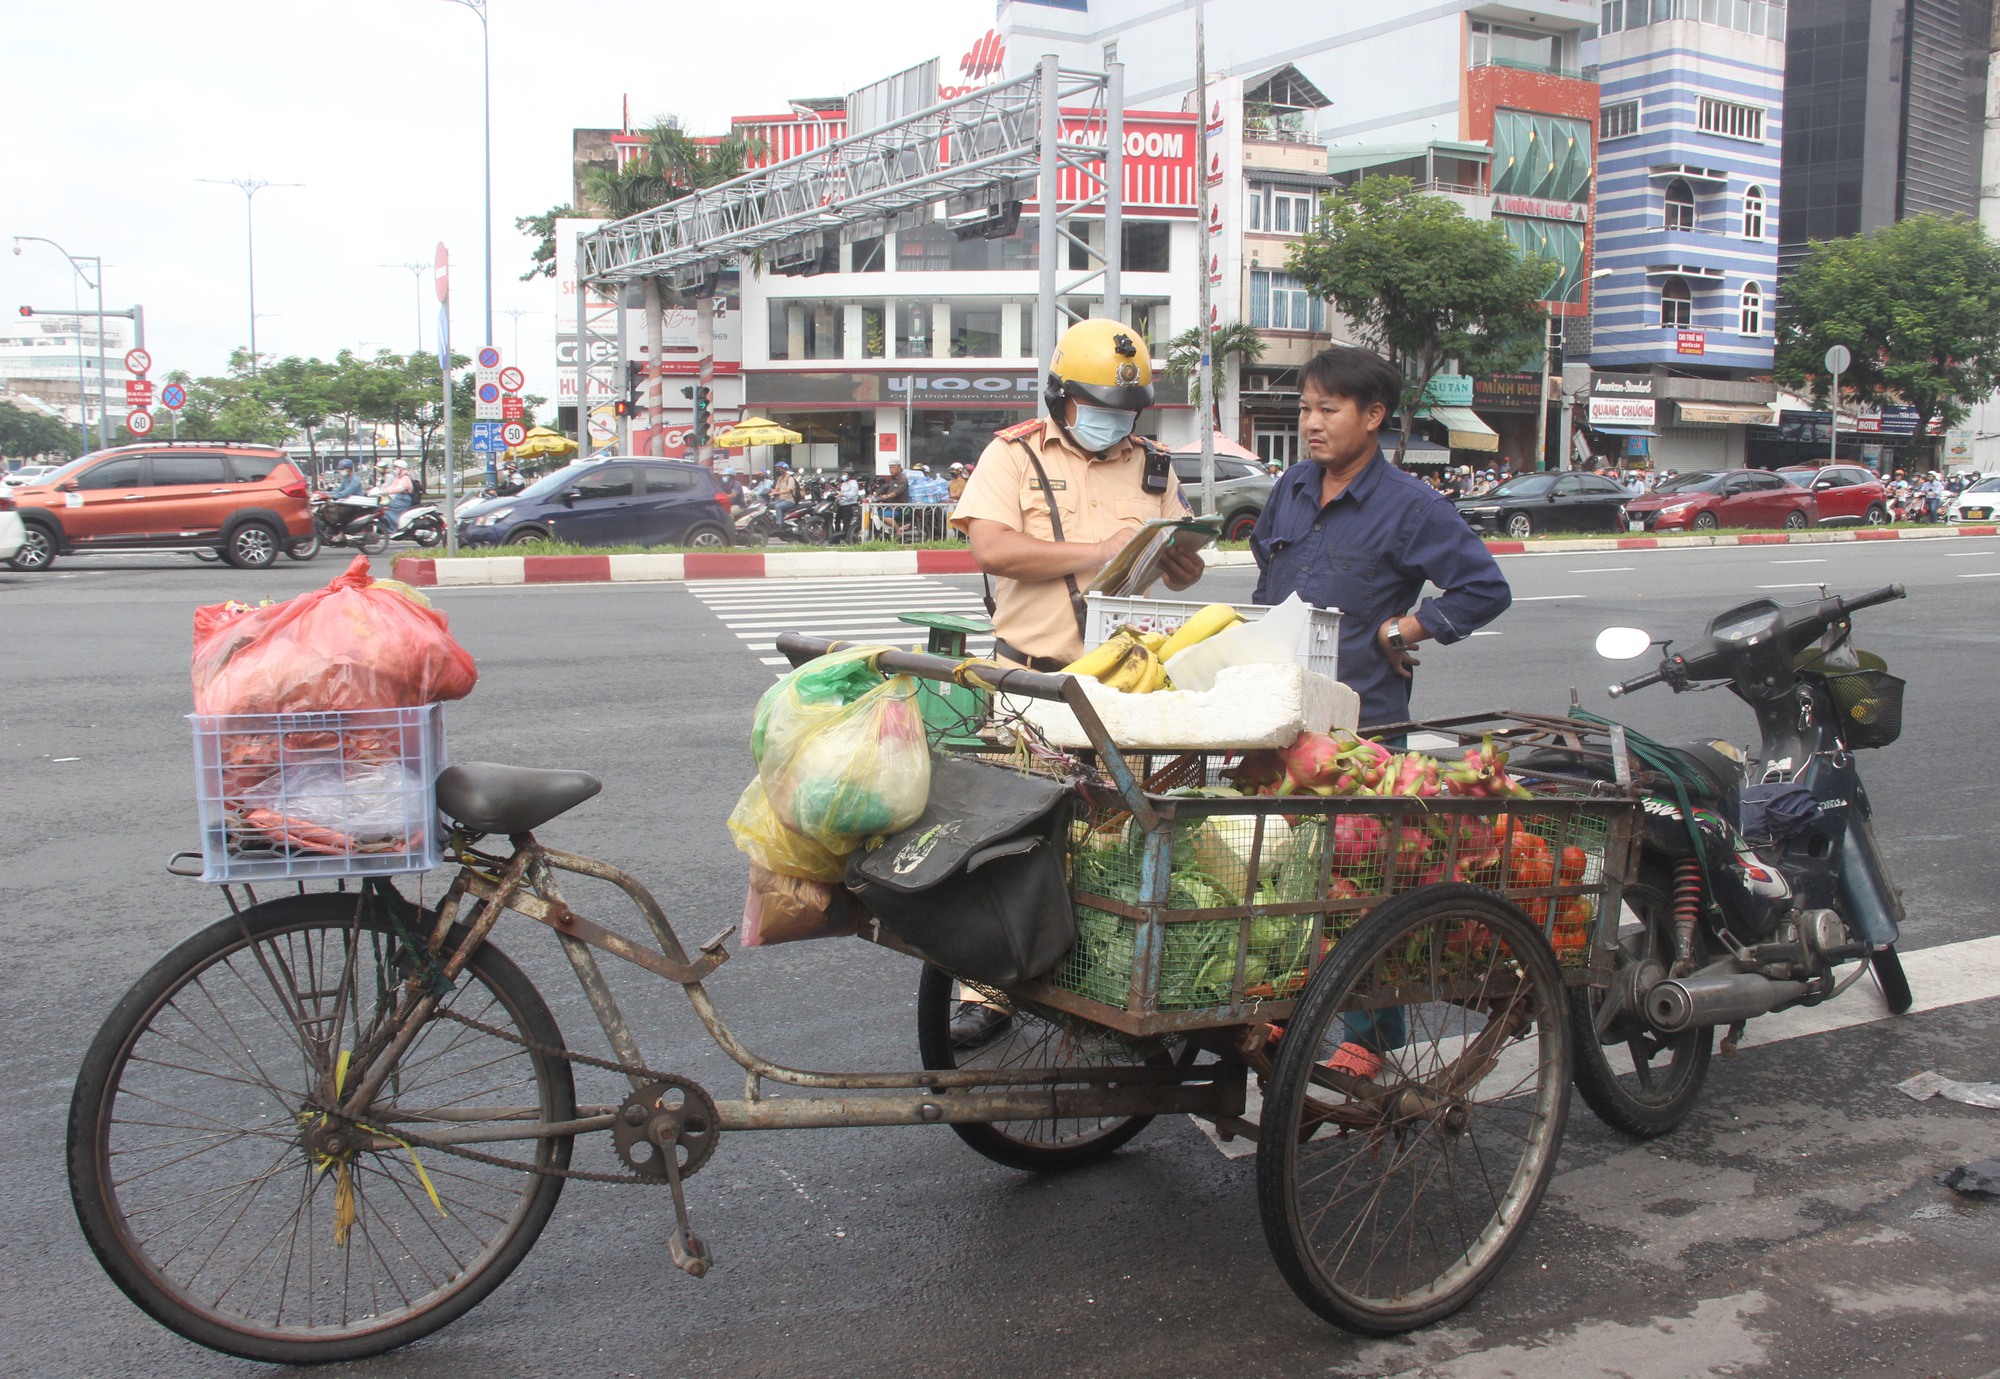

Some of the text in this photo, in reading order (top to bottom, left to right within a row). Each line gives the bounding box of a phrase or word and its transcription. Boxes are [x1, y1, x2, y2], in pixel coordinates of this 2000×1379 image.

[134, 416, 146, 429] 60
[1858, 421, 1878, 430] MOTUL
[508, 428, 521, 440] 50
